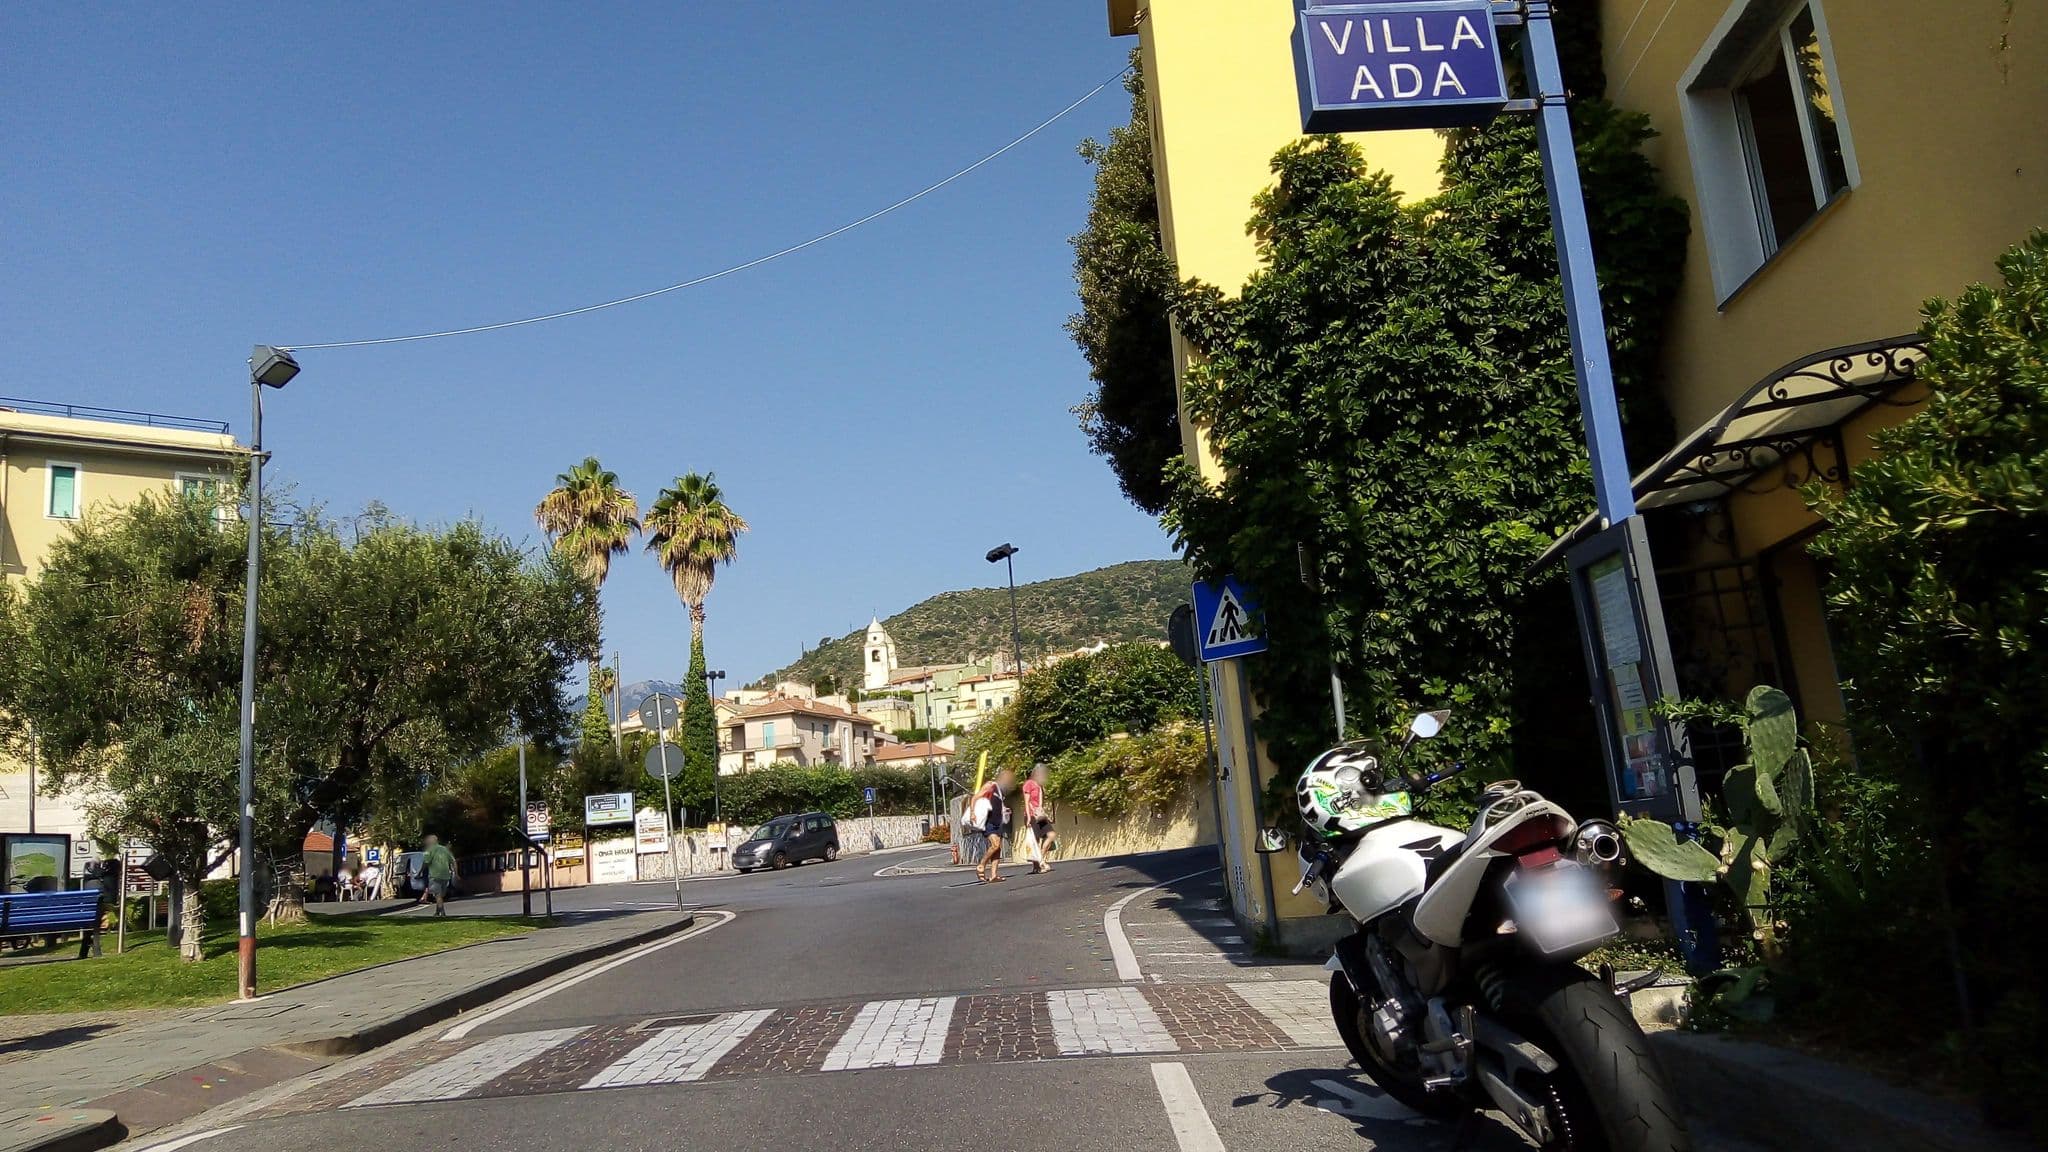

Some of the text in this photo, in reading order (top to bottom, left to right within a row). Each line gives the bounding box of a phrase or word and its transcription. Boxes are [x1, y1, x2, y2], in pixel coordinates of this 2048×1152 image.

[1319, 15, 1485, 55] VILLA
[1350, 61, 1467, 100] ADA
[369, 850, 377, 860] P
